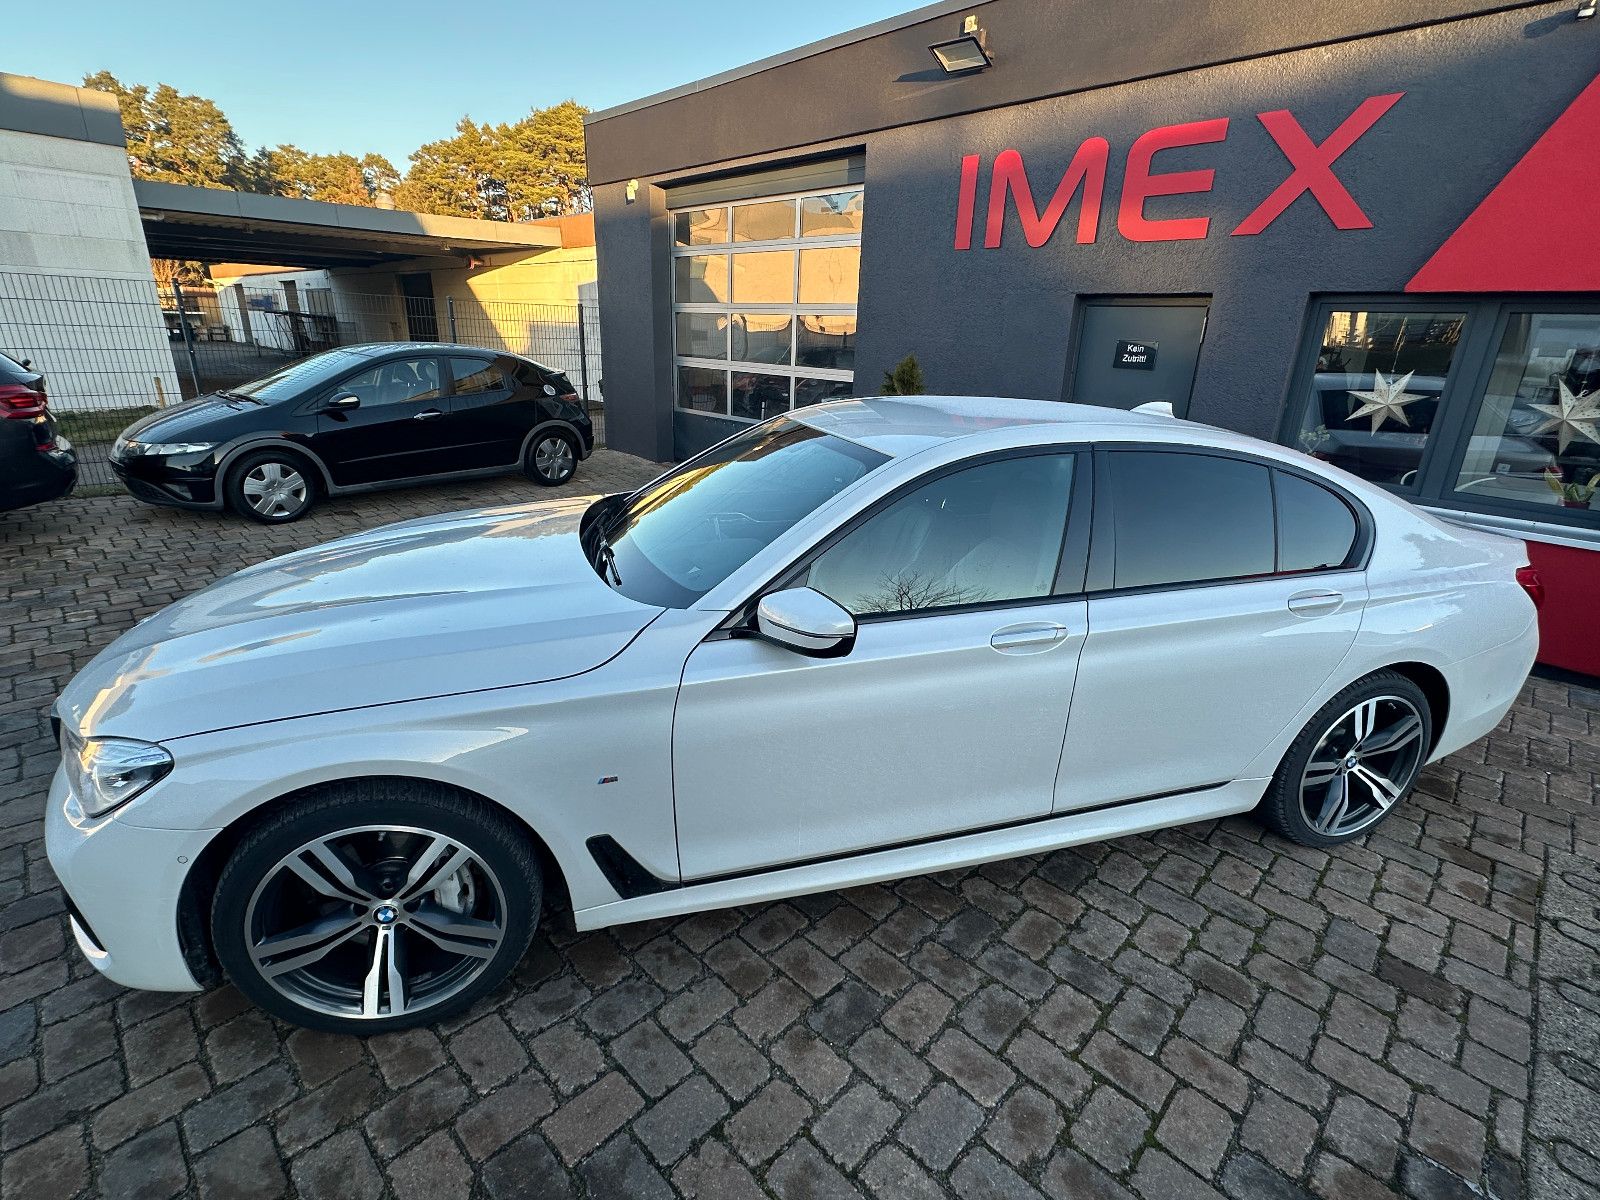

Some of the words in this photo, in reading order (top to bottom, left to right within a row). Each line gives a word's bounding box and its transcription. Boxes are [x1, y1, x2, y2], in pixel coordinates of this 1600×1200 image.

[954, 92, 1407, 250] IMEX
[1127, 344, 1145, 353] Kein
[1122, 354, 1147, 363] Zutritt!
